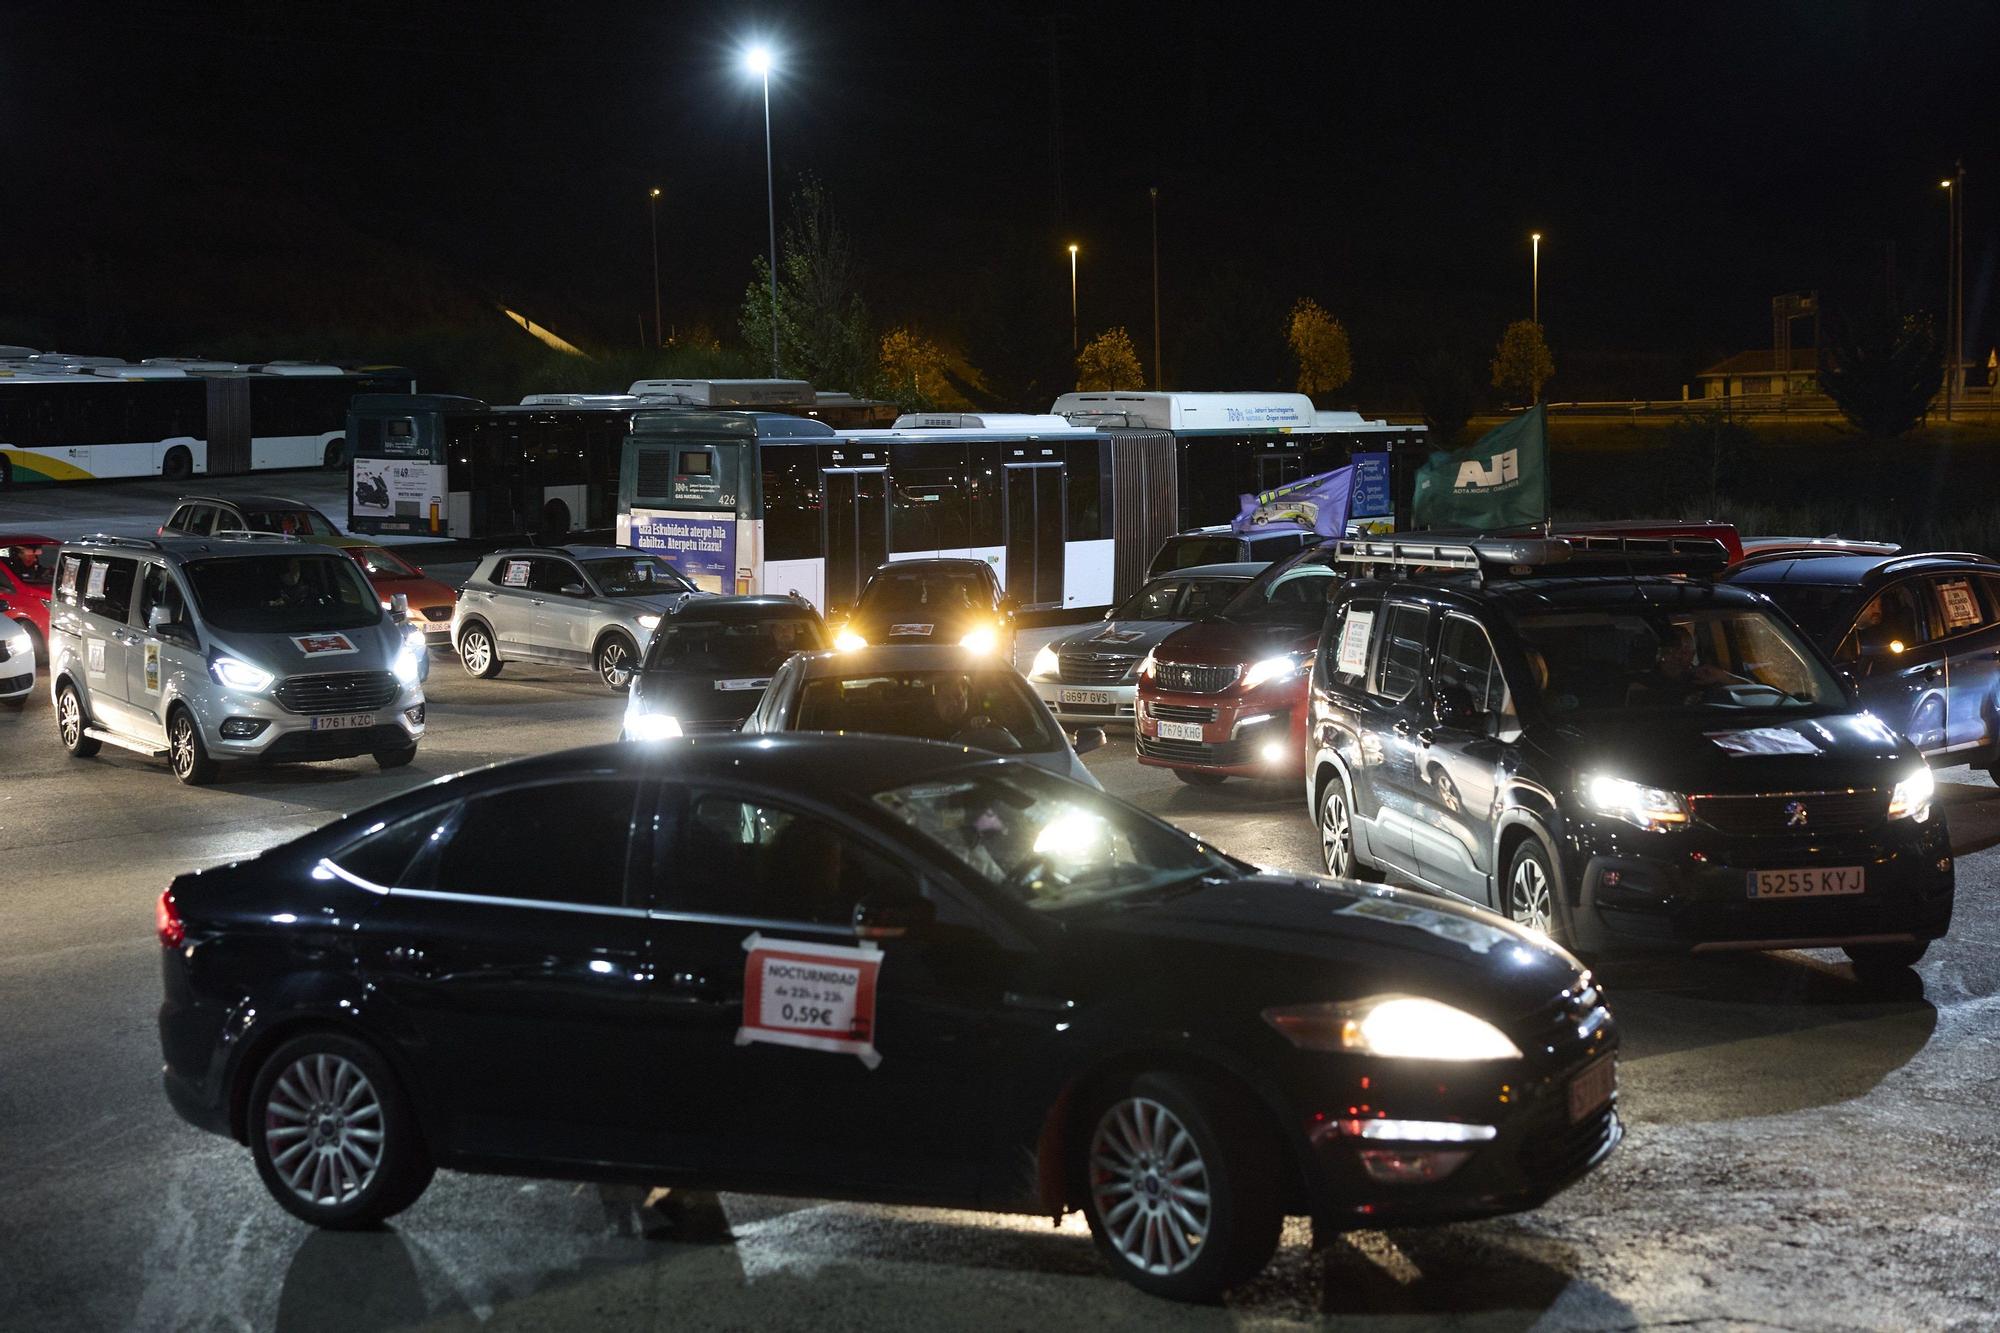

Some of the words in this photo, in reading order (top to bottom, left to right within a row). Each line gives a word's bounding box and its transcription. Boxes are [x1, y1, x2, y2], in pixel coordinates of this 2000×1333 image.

[416, 448, 429, 456] 430
[718, 494, 736, 505] 426
[652, 523, 690, 537] Eskubideak
[689, 526, 712, 540] aterpe
[712, 526, 726, 539] bila
[638, 536, 667, 549] dabiltza.
[667, 537, 698, 552] Aterpetu
[698, 539, 722, 552] itzazu!
[1089, 693, 1108, 703] GVS
[319, 716, 346, 728] 1761
[350, 715, 371, 727] KZC
[1163, 723, 1182, 737] 7679
[1184, 725, 1201, 738] KHG
[1761, 873, 1815, 895] 5255
[1821, 871, 1861, 892] KYJ
[768, 965, 857, 986] NOCTURNIDAD
[781, 1003, 833, 1026] 0,59€
